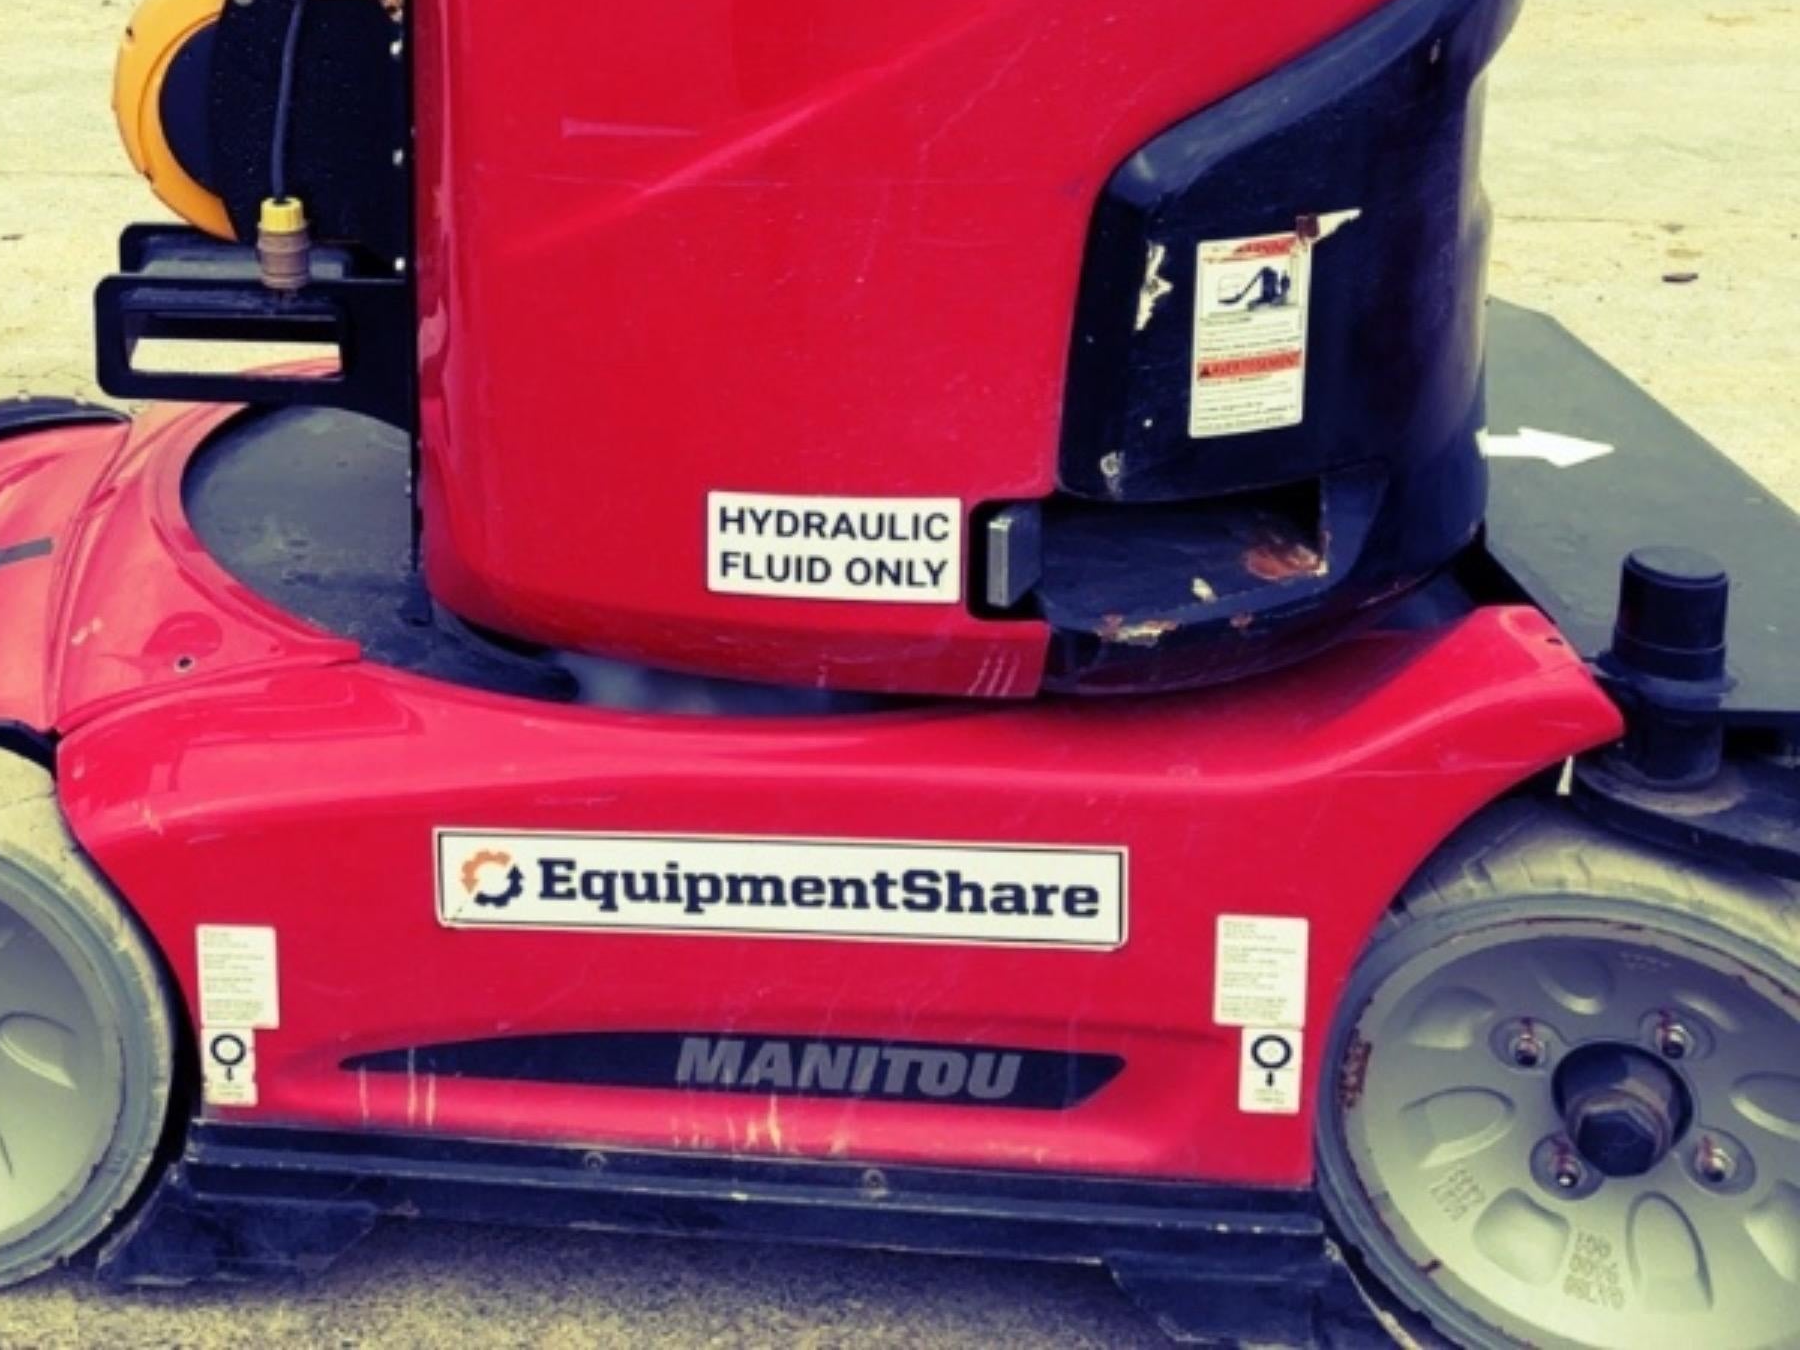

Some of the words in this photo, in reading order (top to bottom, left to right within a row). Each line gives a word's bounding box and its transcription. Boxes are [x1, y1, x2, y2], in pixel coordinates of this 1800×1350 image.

[718, 506, 950, 542] HYDRAULIC
[719, 550, 832, 585] FLUID
[844, 556, 949, 588] ONLY
[536, 857, 1100, 918] EquipmentShare
[675, 1036, 1024, 1099] MANITOU
